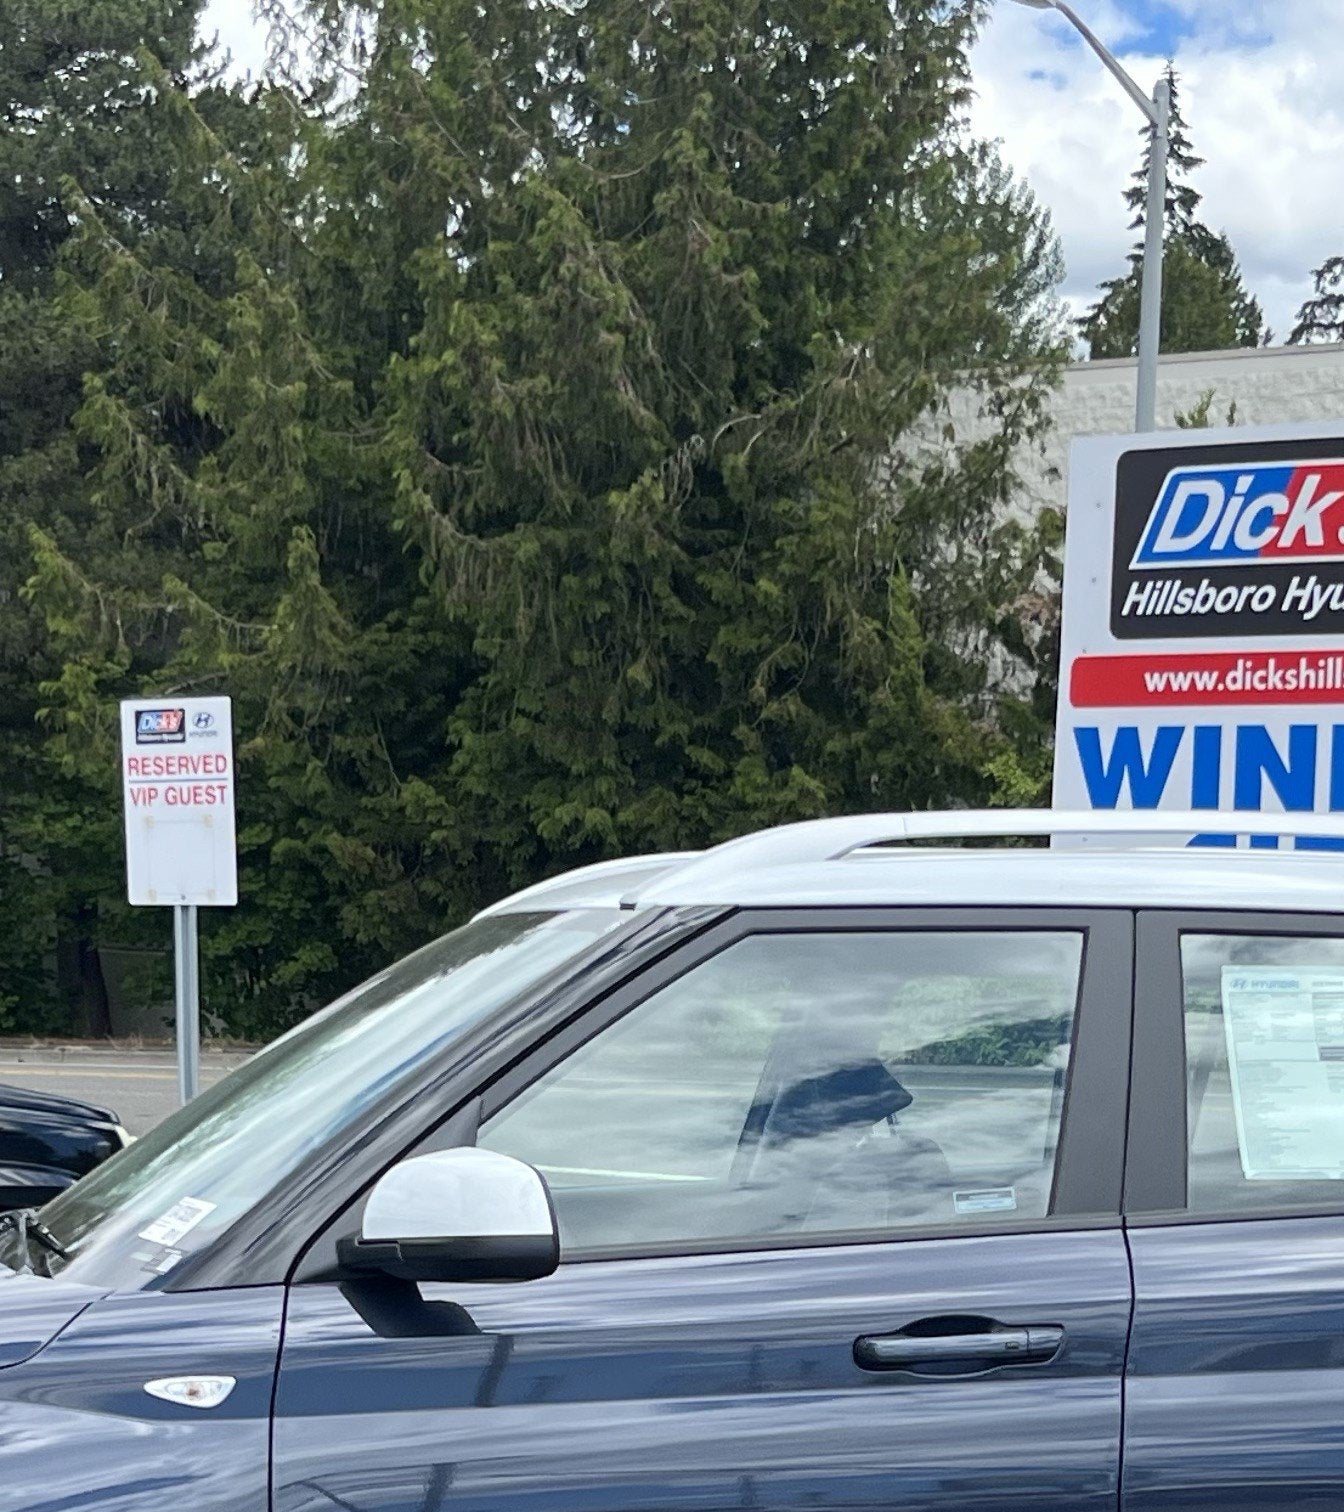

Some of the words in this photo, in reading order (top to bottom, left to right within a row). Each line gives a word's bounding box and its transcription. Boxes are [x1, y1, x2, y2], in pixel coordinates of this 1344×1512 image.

[1121, 578, 1277, 617] Hillsboro
[128, 754, 227, 776] RESERVED
[130, 787, 158, 806] VIP
[165, 785, 227, 805] GUEST
